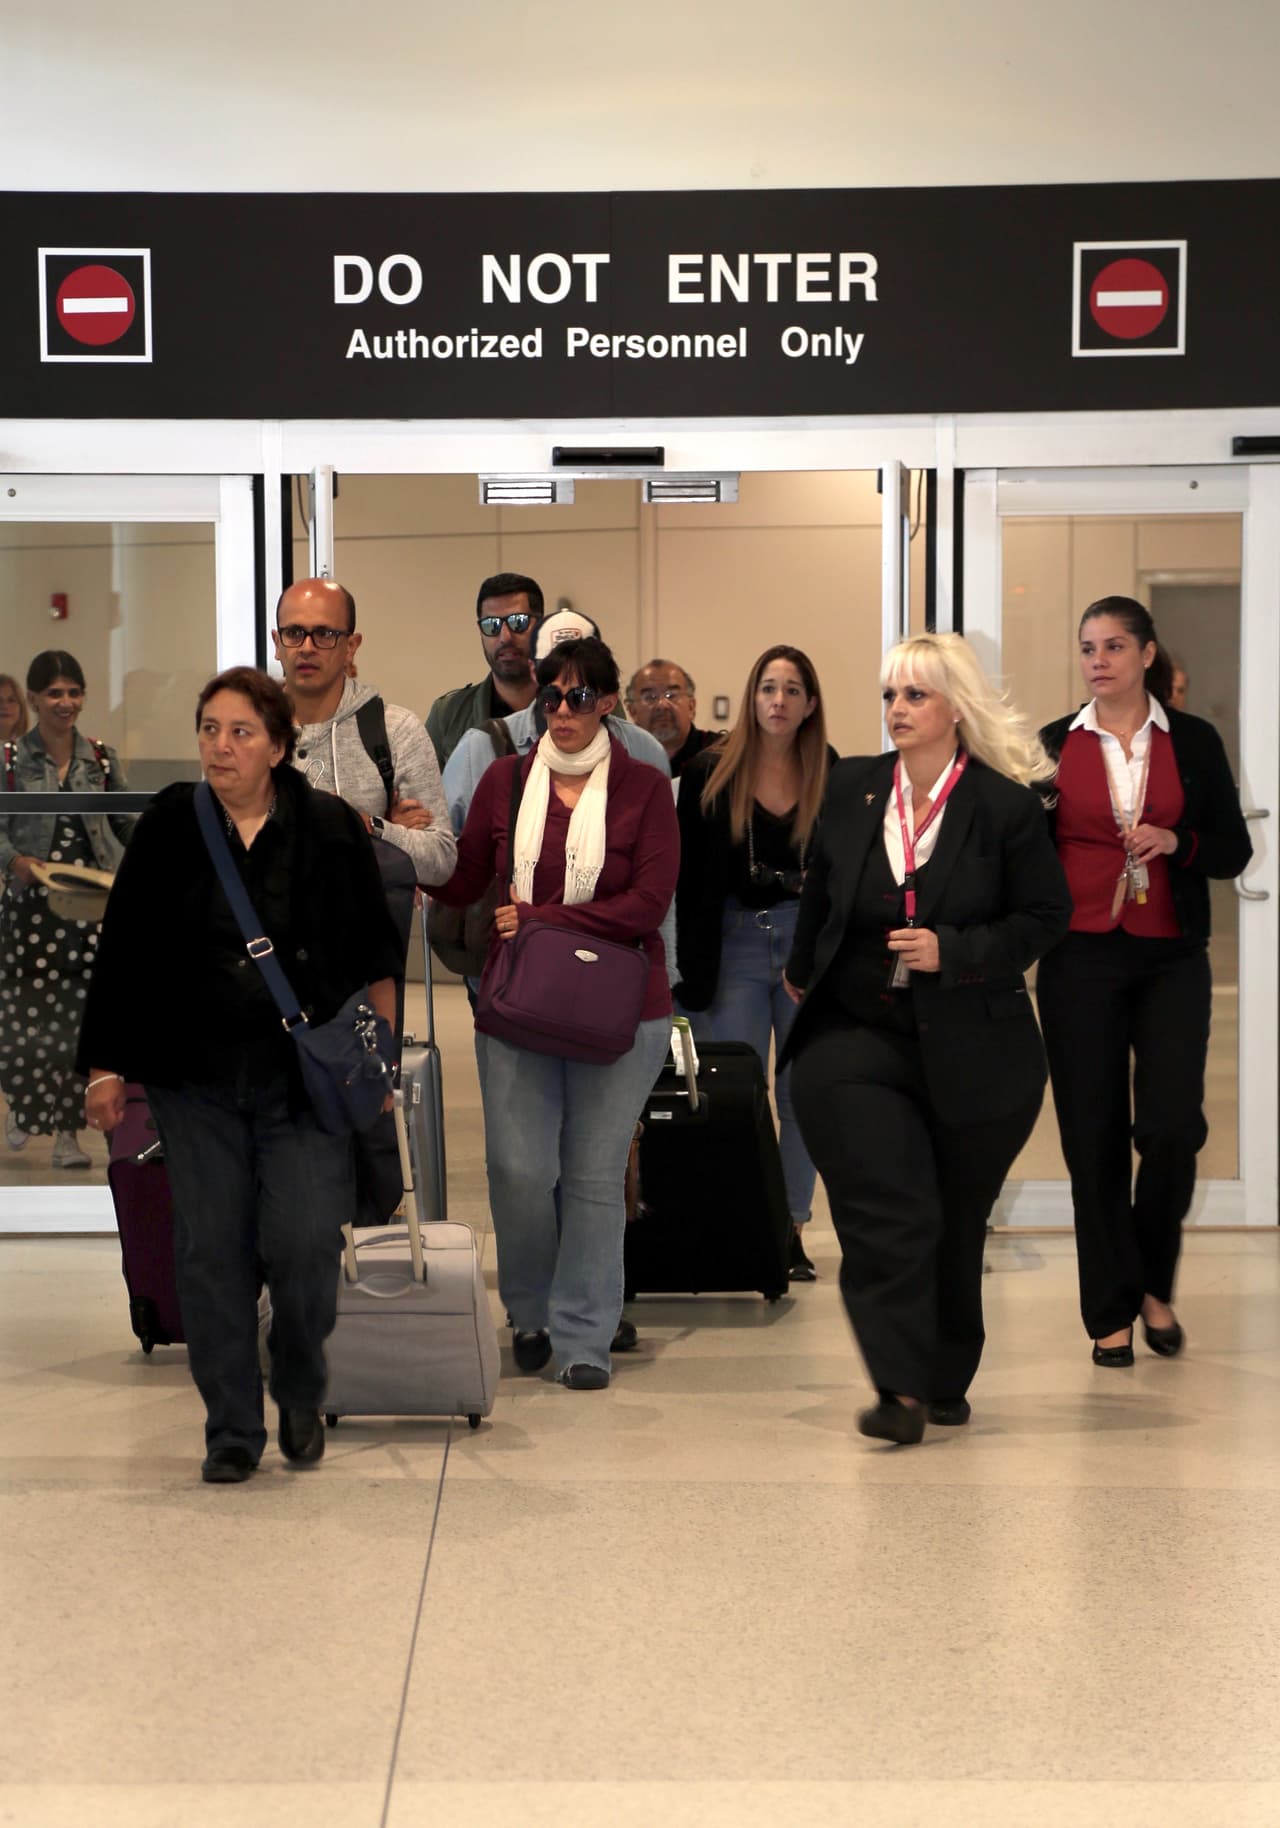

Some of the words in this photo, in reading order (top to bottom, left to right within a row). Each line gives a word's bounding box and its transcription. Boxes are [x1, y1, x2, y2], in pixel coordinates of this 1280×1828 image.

[333, 254, 423, 305] DO
[482, 252, 610, 304] NOT
[668, 252, 878, 303] ENTER
[345, 328, 543, 359] Authorized
[567, 327, 747, 358] Personnel
[781, 326, 865, 365] Only
